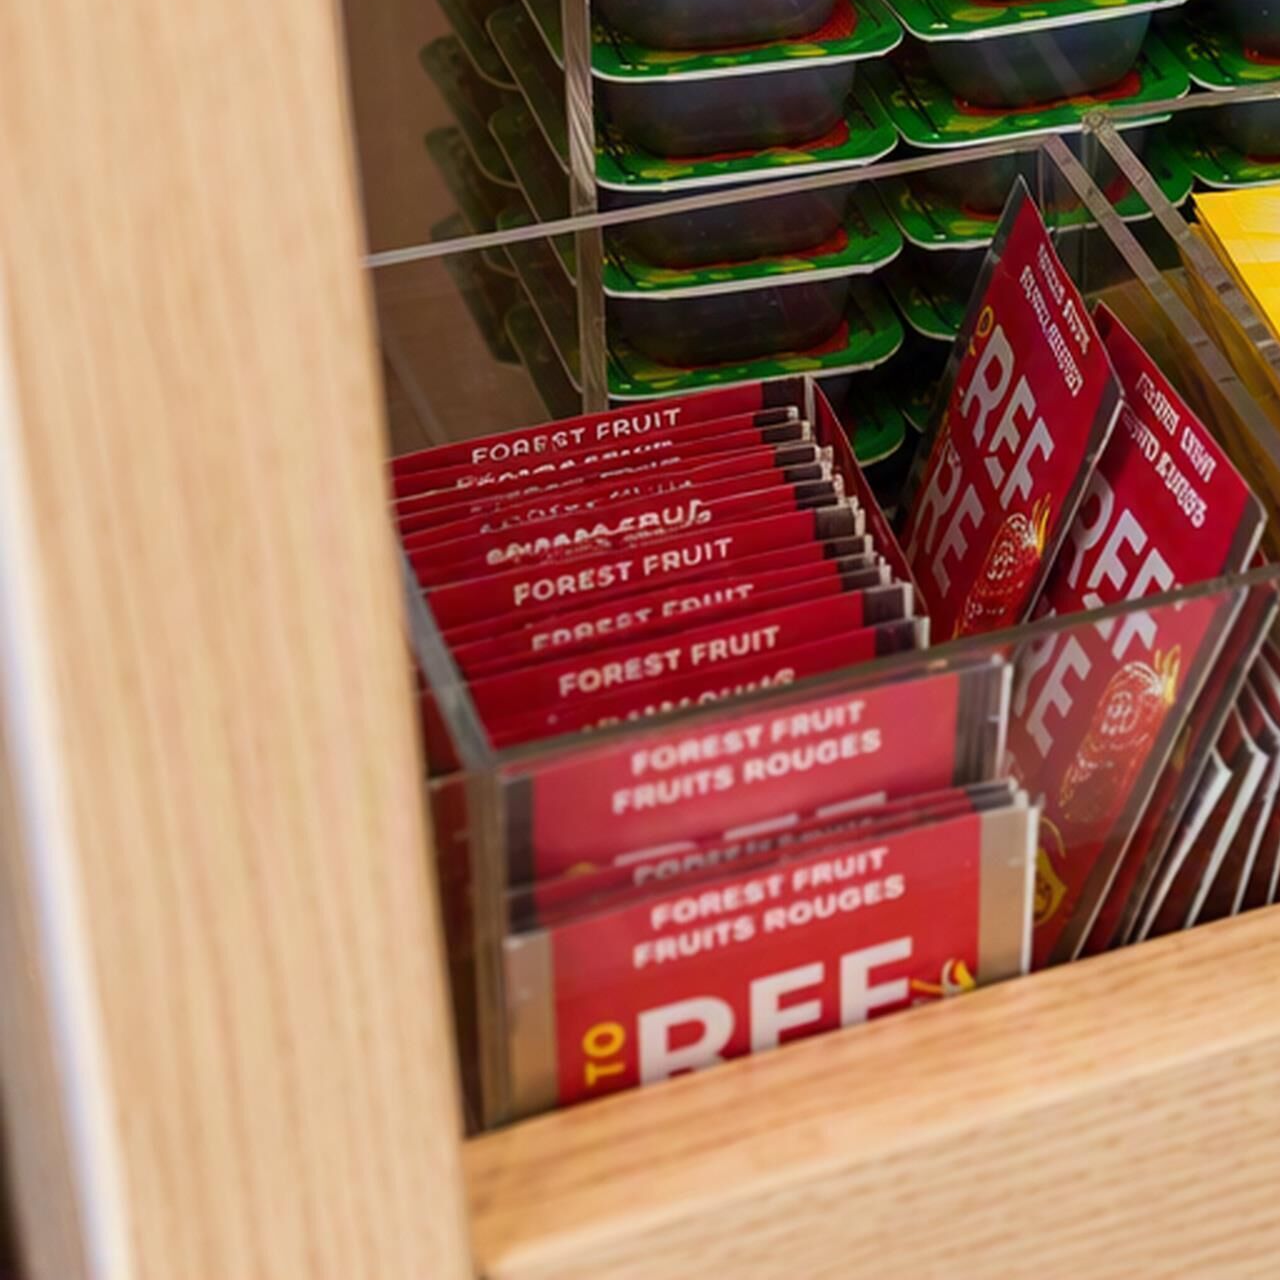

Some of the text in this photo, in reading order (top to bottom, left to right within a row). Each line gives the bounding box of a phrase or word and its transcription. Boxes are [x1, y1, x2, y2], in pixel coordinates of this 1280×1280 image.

[596, 407, 682, 441] FRUIT
[513, 537, 733, 606] FOREST FRUIT
[558, 625, 780, 697] FOREST FRUIT
[612, 729, 882, 815] FRUITS ROUGES
[631, 725, 763, 776] FOREST
[771, 700, 865, 743] FRUIT
[633, 874, 906, 970] FRUITS ROUGES
[651, 877, 785, 929] FOREST
[793, 847, 890, 891] FRUIT
[582, 1022, 626, 1088] TO
